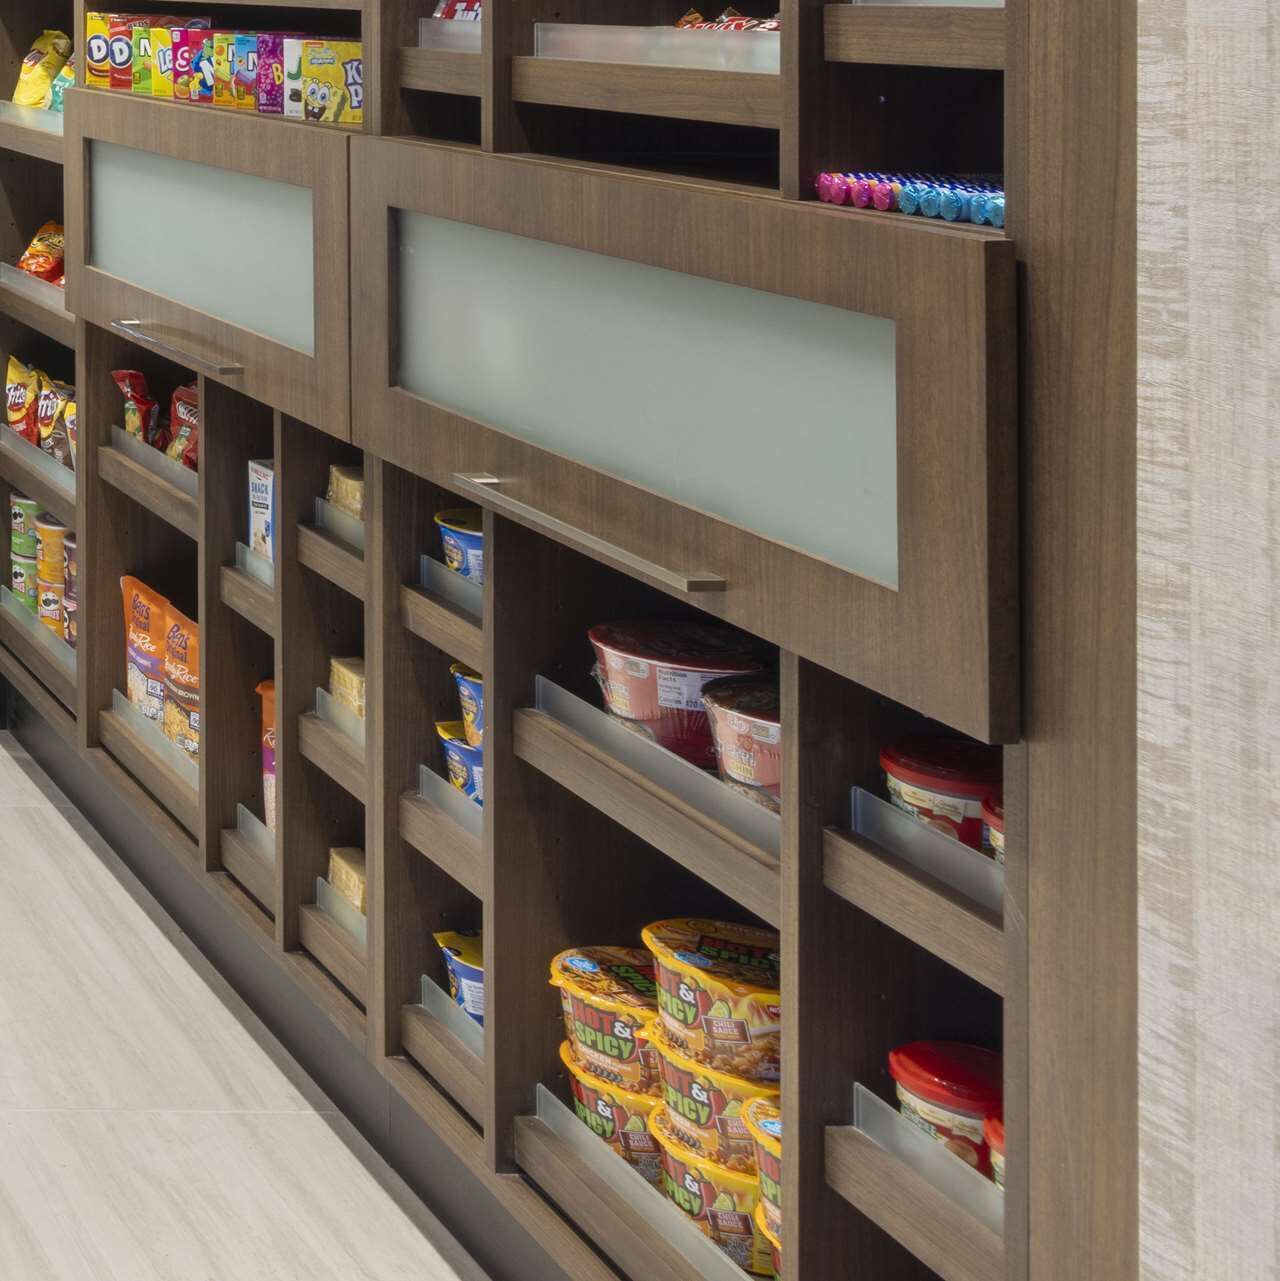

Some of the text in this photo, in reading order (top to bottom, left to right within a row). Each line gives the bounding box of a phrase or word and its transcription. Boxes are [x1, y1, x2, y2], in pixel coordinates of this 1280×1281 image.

[679, 983, 697, 1005] &
[572, 999, 632, 1039] HOT &
[574, 1020, 635, 1060] SPICY
[691, 1083, 710, 1104] &
[596, 1099, 614, 1120] &
[684, 1172, 701, 1196] &
